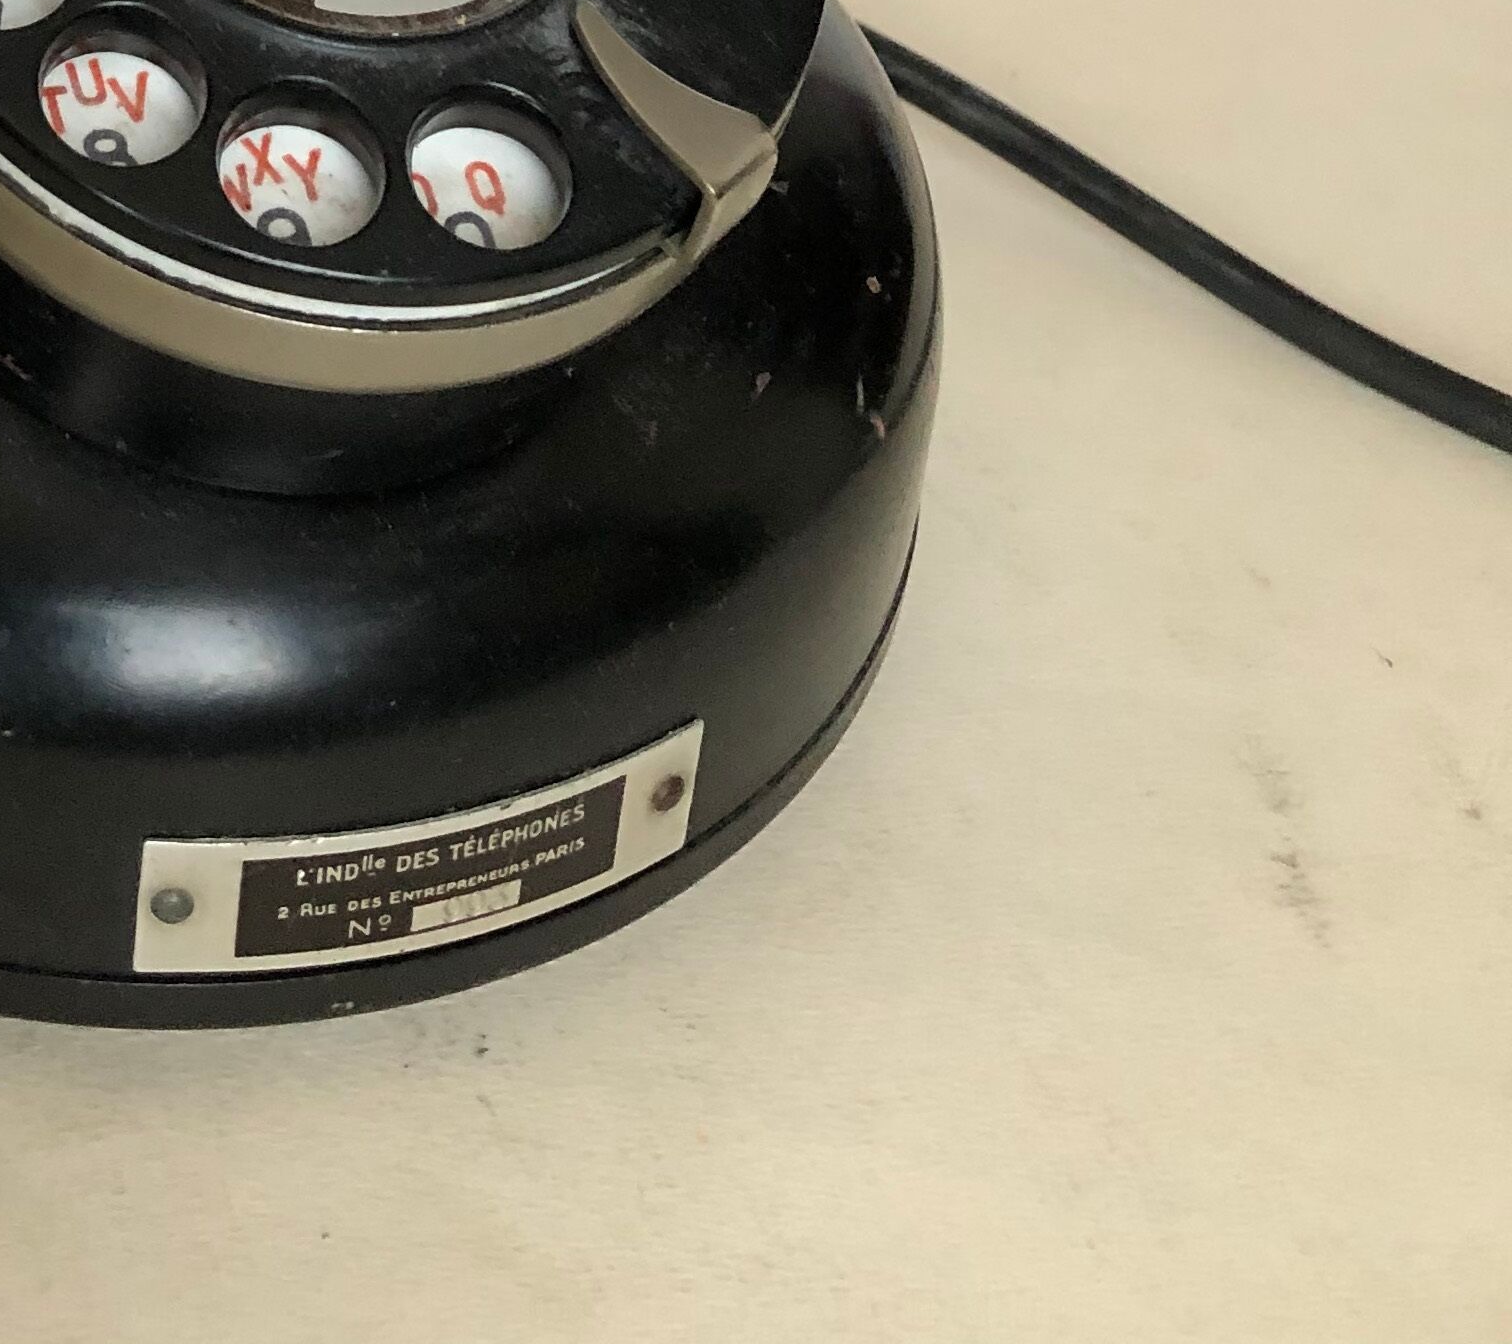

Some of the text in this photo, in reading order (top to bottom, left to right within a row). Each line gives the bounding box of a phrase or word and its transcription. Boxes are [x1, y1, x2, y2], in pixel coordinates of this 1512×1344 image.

[40, 57, 150, 135] TUV
[396, 847, 440, 873] DES
[449, 803, 585, 861] TÉLÉPHONES
[277, 906, 289, 920] 2
[535, 836, 586, 865] PARIS
